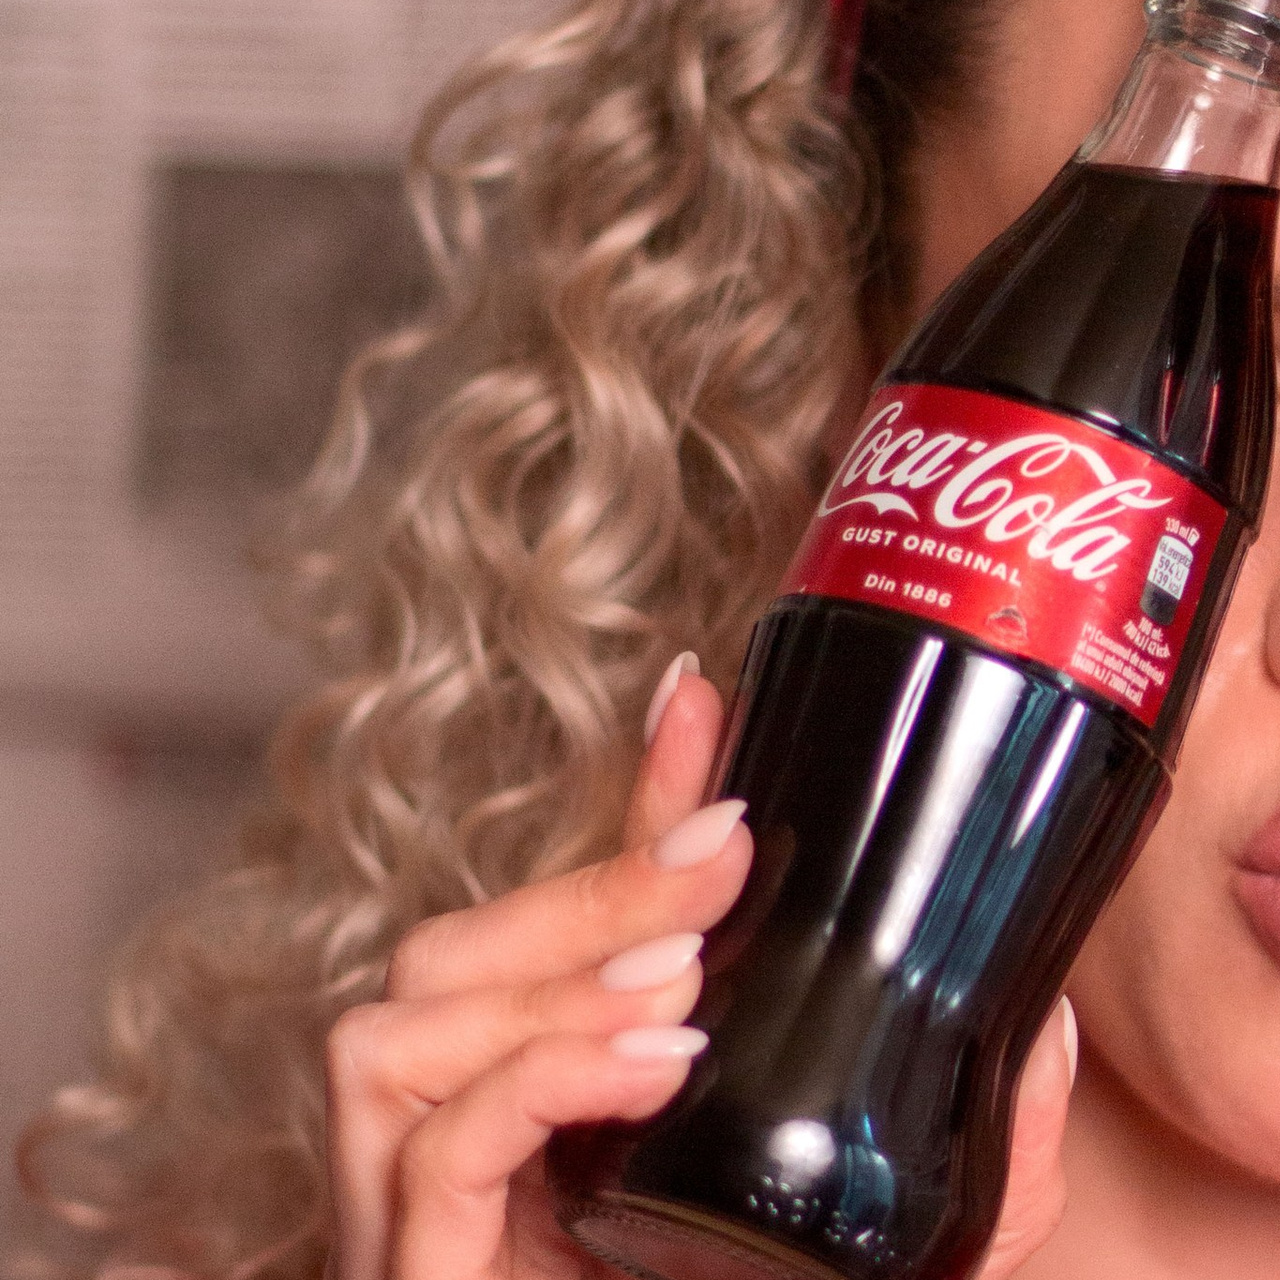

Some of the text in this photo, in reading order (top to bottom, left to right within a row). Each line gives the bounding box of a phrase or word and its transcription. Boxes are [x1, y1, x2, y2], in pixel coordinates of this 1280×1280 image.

[842, 526, 1022, 587] GUST ORIGINAL
[1157, 557, 1175, 574] 594
[864, 572, 953, 608] Din 1886
[1151, 568, 1168, 586] 139
